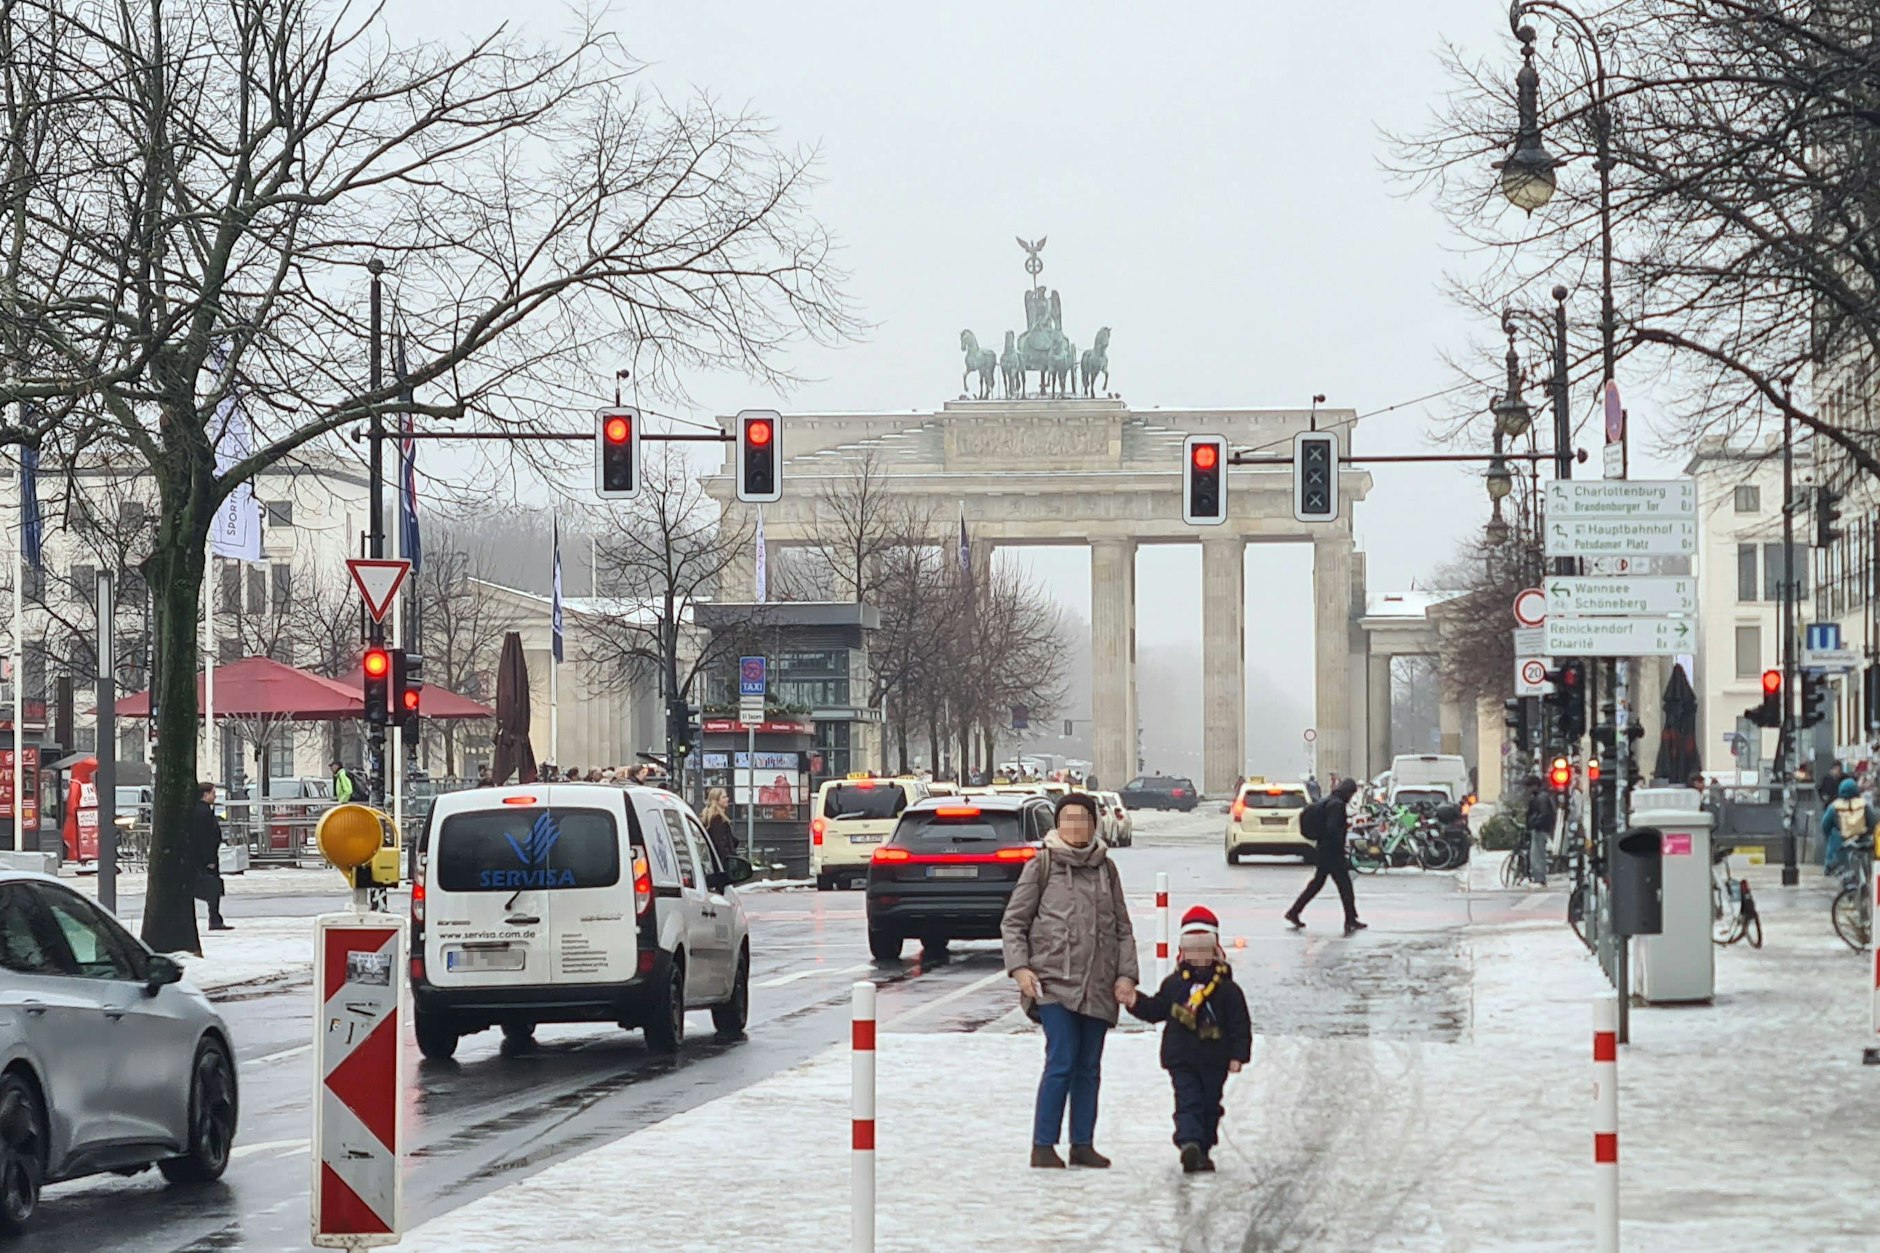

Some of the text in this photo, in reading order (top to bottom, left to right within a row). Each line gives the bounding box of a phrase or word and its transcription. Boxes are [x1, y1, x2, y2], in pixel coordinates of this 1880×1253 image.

[1575, 486, 1666, 499] Charlottenburg
[1574, 502, 1641, 514] Brandenburger
[1647, 502, 1660, 511] Tor
[1588, 524, 1673, 536] Hauptbahnhof
[1574, 539, 1622, 549] Potsdamer
[1626, 539, 1649, 549] Platz
[1574, 582, 1687, 594] Wannsee 21
[1574, 598, 1648, 611] Schöneberg
[1550, 623, 1634, 635] Reinickendorf
[1550, 637, 1594, 649] Charité
[1812, 627, 1836, 651] U
[1527, 666, 1542, 679] 20
[743, 682, 763, 692] TAXI
[480, 869, 576, 887] SERVISA
[438, 930, 536, 940] www.servisa.com.de
